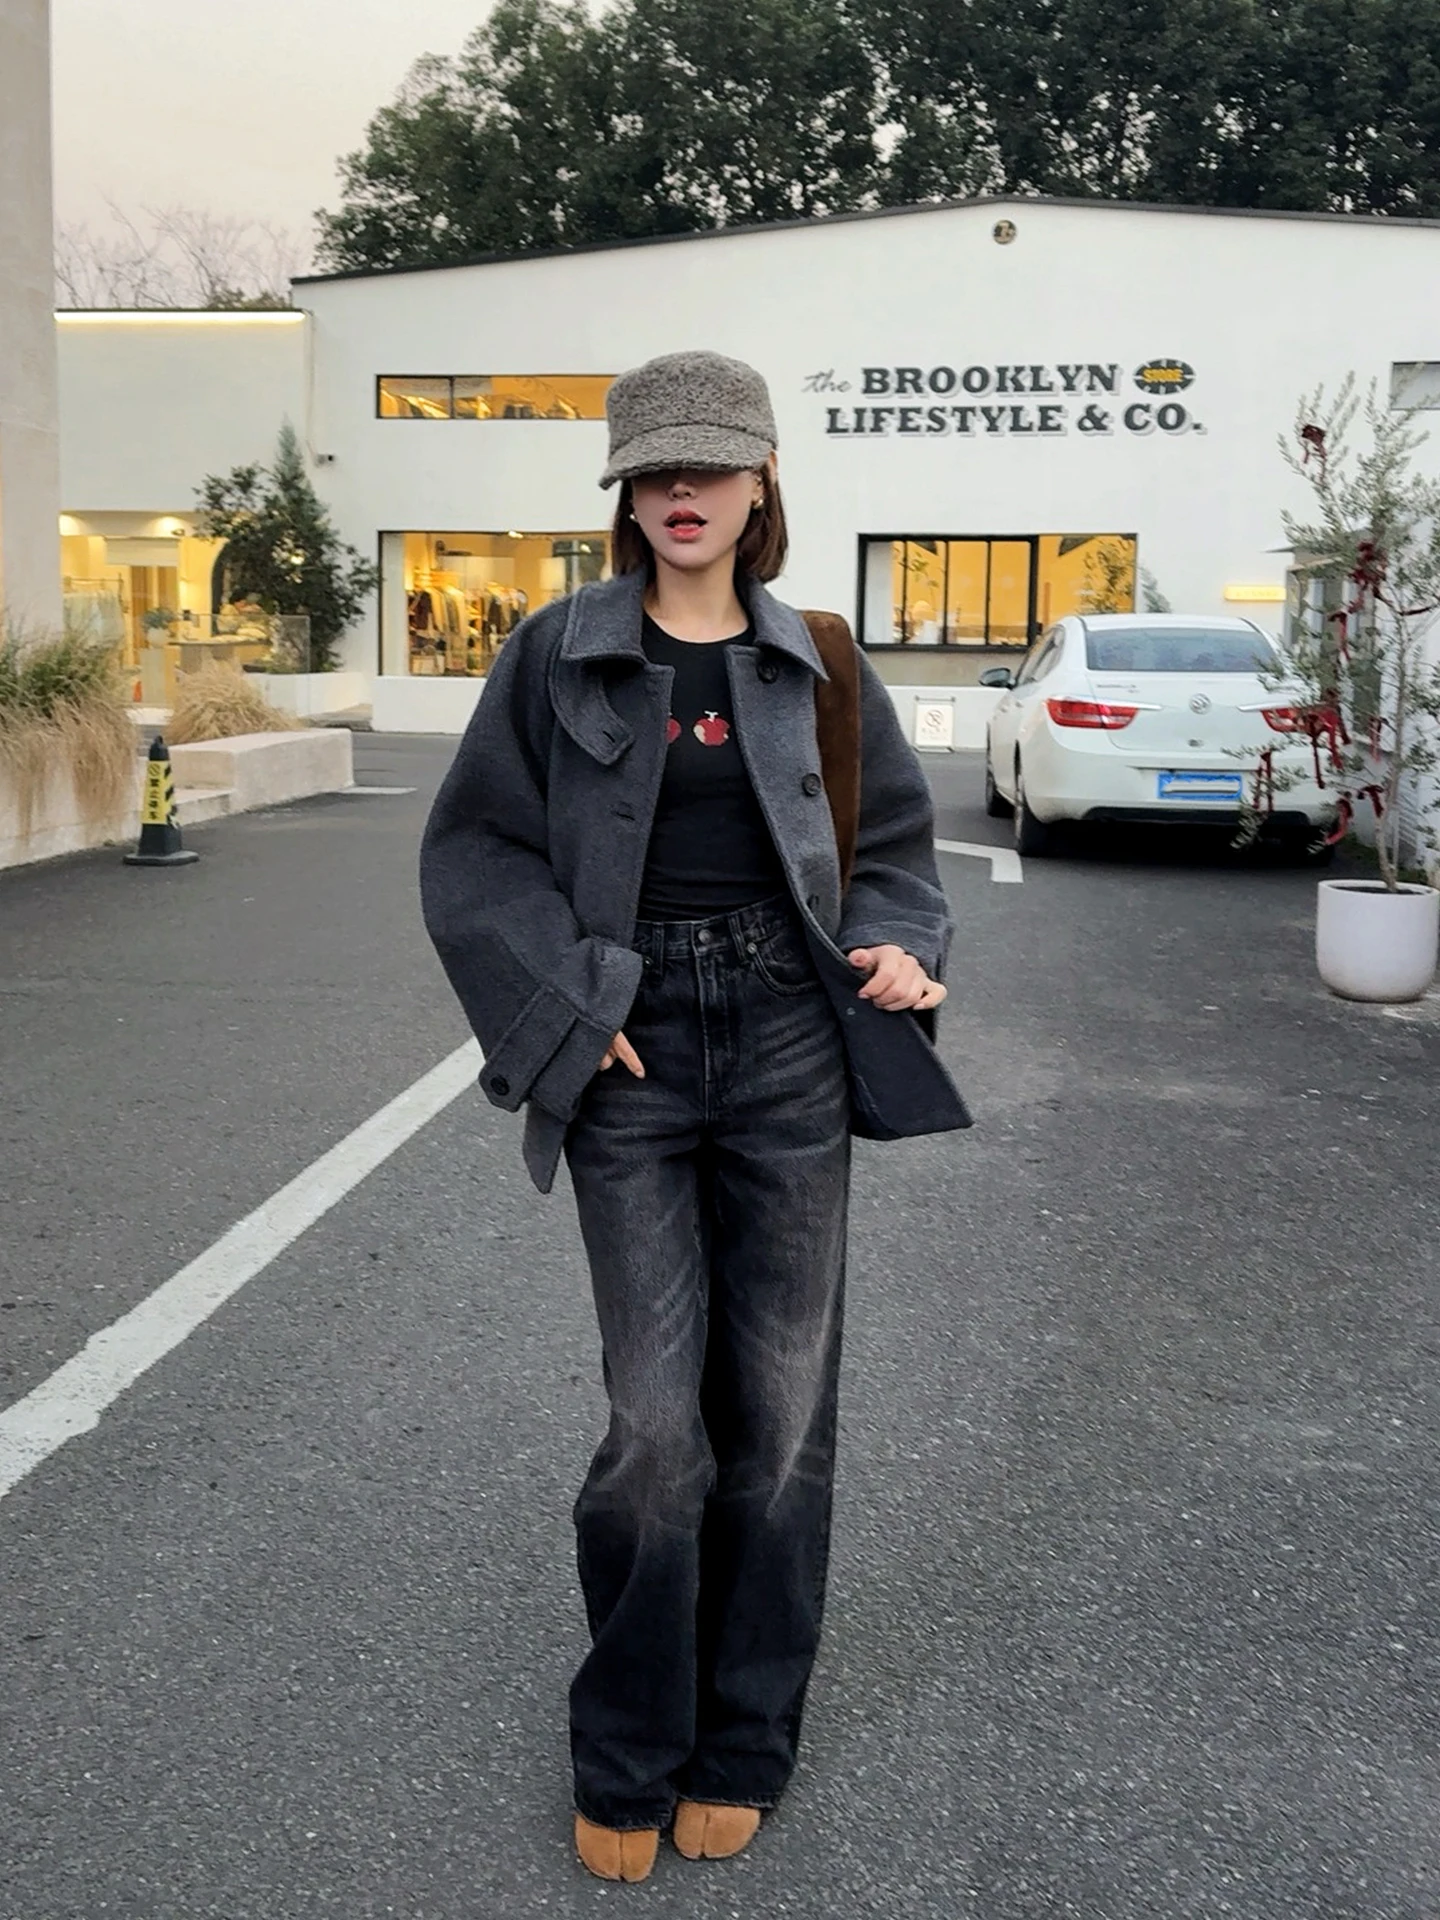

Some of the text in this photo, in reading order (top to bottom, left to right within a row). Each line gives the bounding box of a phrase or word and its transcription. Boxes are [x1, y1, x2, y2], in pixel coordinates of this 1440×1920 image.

[801, 364, 1120, 396] the BROOKLYN
[826, 402, 1205, 436] LIFESTYLE & CO.
